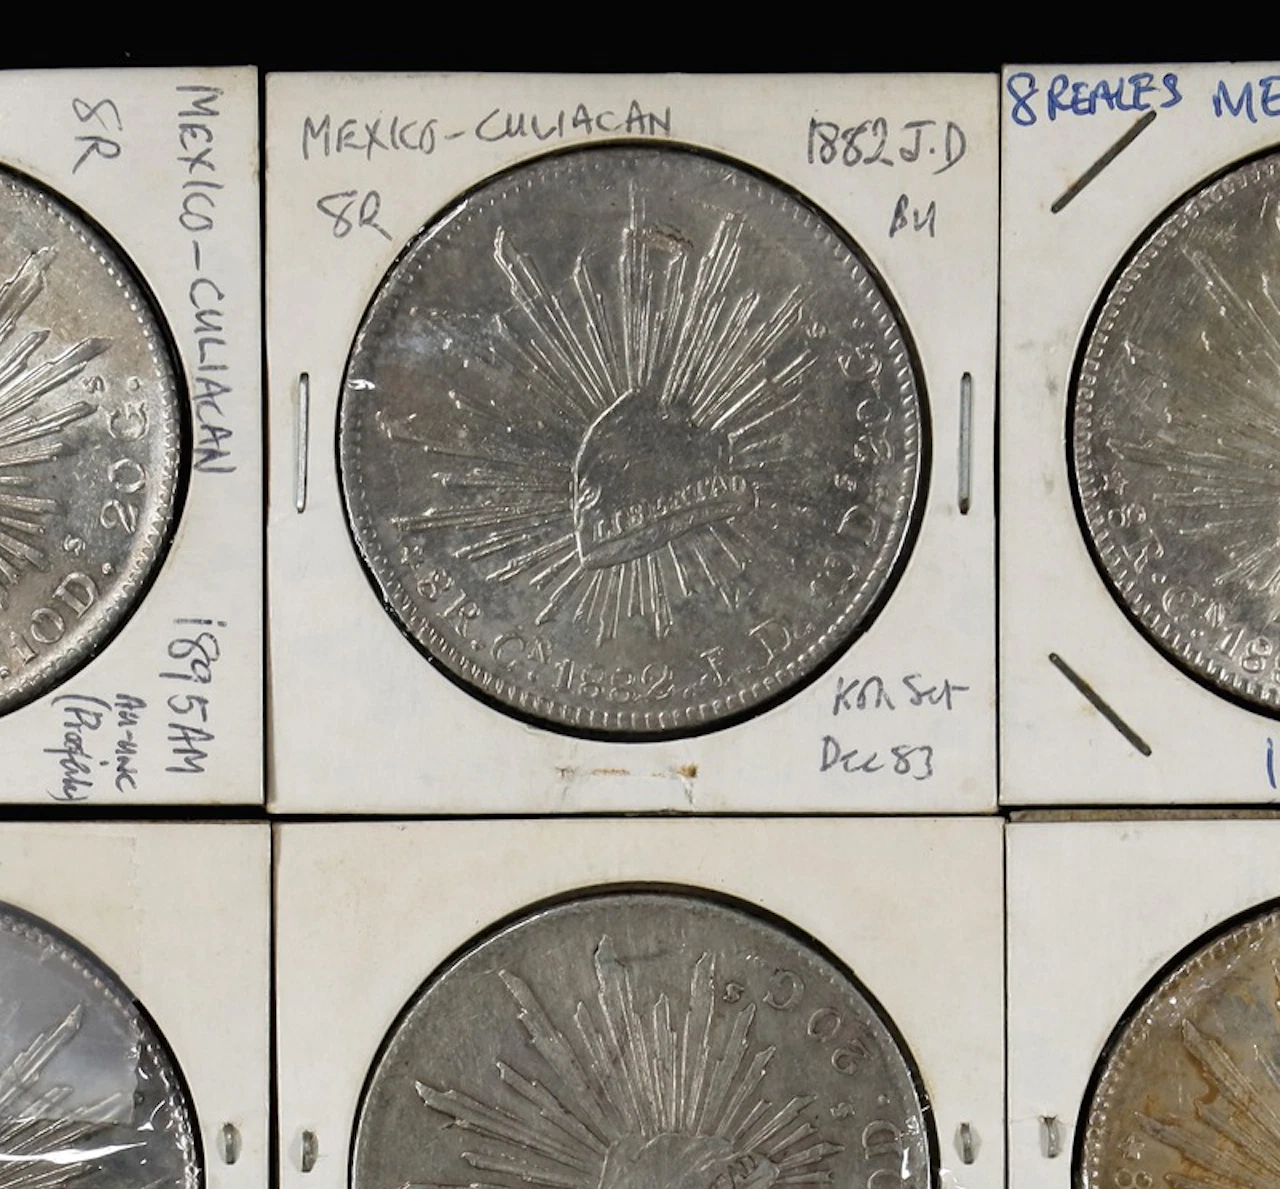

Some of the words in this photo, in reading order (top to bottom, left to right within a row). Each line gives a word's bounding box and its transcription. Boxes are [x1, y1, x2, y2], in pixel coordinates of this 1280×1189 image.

[71, 98, 123, 176] 8R
[807, 117, 897, 167] 1882
[316, 191, 393, 240] 8R
[891, 743, 935, 779] 83
